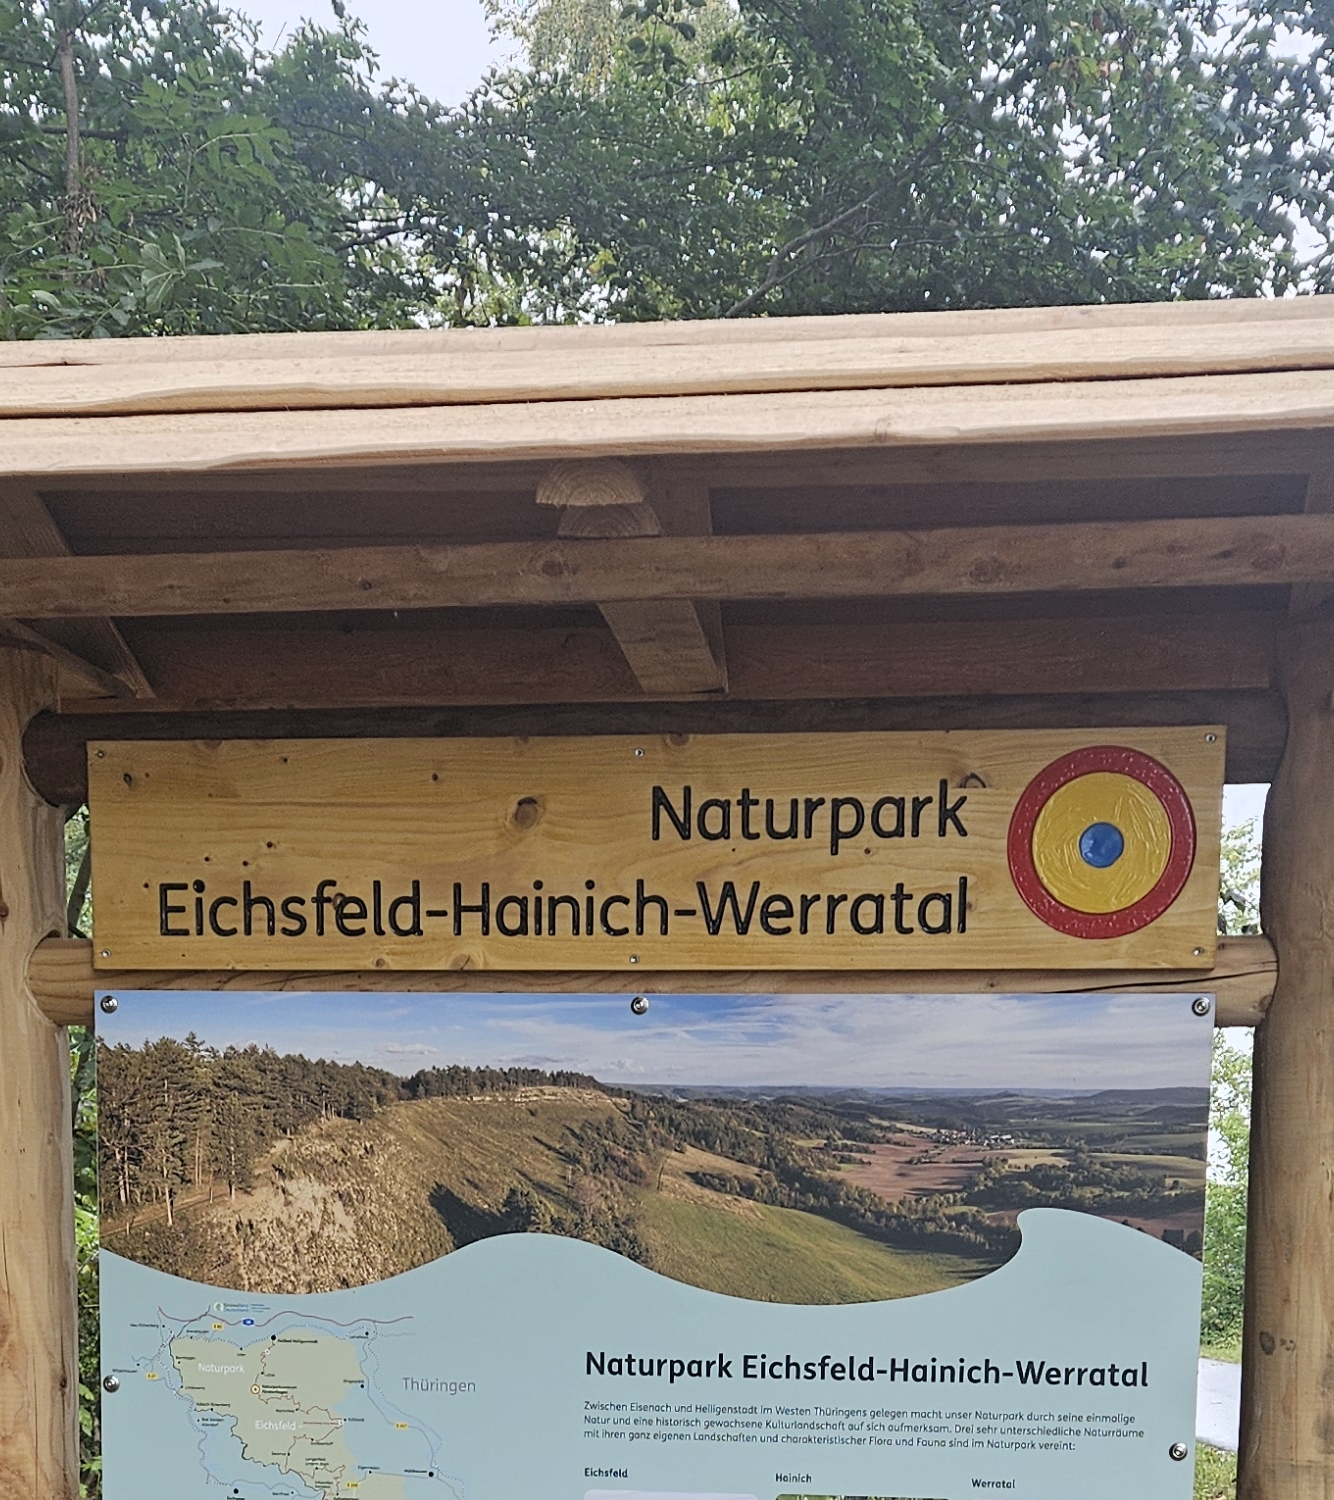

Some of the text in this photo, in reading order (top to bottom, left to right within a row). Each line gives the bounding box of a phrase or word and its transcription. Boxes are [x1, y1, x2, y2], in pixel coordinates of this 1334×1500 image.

[651, 779, 968, 855] Naturpark
[158, 877, 969, 937] Eichsfeld-Hainich-Werratal
[198, 1363, 245, 1374] Naturpark
[586, 1350, 1149, 1387] Naturpark Eichsfeld-Hainich-Werratal
[402, 1377, 476, 1395] Thüringen
[583, 1400, 1135, 1426] Zwischen Eisenach und Heiligenstadt im Westen Thüringens gelegen macht unser Naturpark durch seine einmalige
[255, 1420, 296, 1431] Eichsfeld
[583, 1414, 1144, 1438] Natur und eine historisch gewachsene Kulturlandschaft auf sich aufmerksam. Drei sehr unterschiedliche Naturräume
[583, 1429, 1075, 1451] mit ihren ganz eigenen Landschaften und charakteristischer Flora und Fauna sind im Naturpark vereint:
[584, 1467, 629, 1478] Eichsfeld
[775, 1473, 812, 1483] Hainich
[971, 1478, 1016, 1489] Werratal
